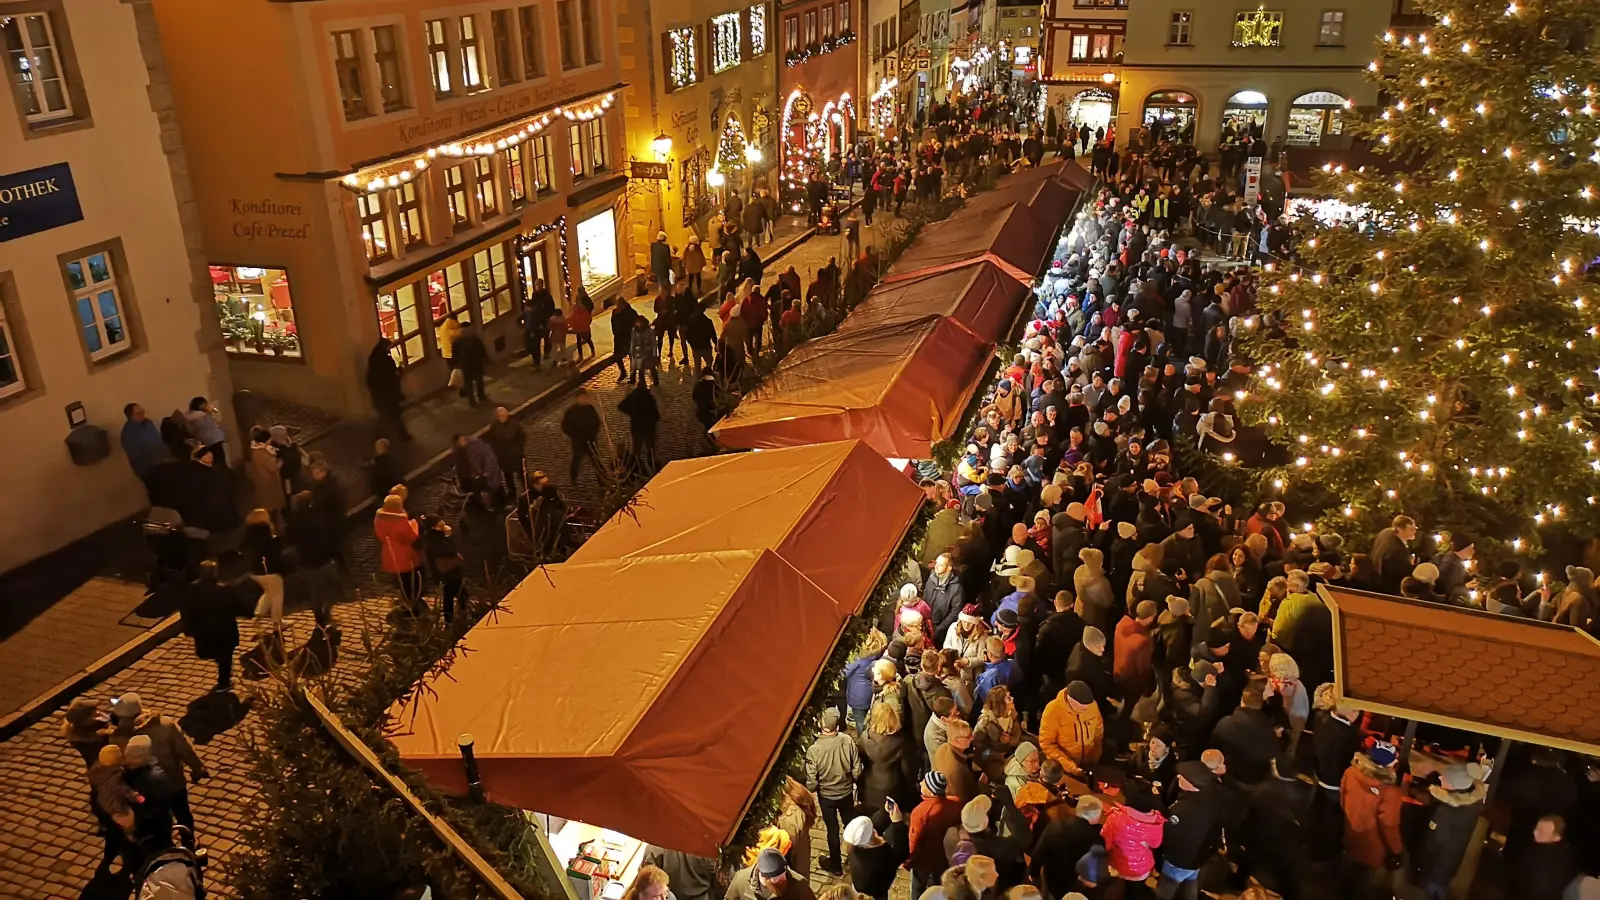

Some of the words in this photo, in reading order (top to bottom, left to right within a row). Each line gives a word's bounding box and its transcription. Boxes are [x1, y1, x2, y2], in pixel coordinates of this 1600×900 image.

[397, 111, 453, 143] Konditorei
[228, 198, 302, 216] Konditorei
[233, 221, 263, 241] Café
[265, 223, 311, 239] Prezel
